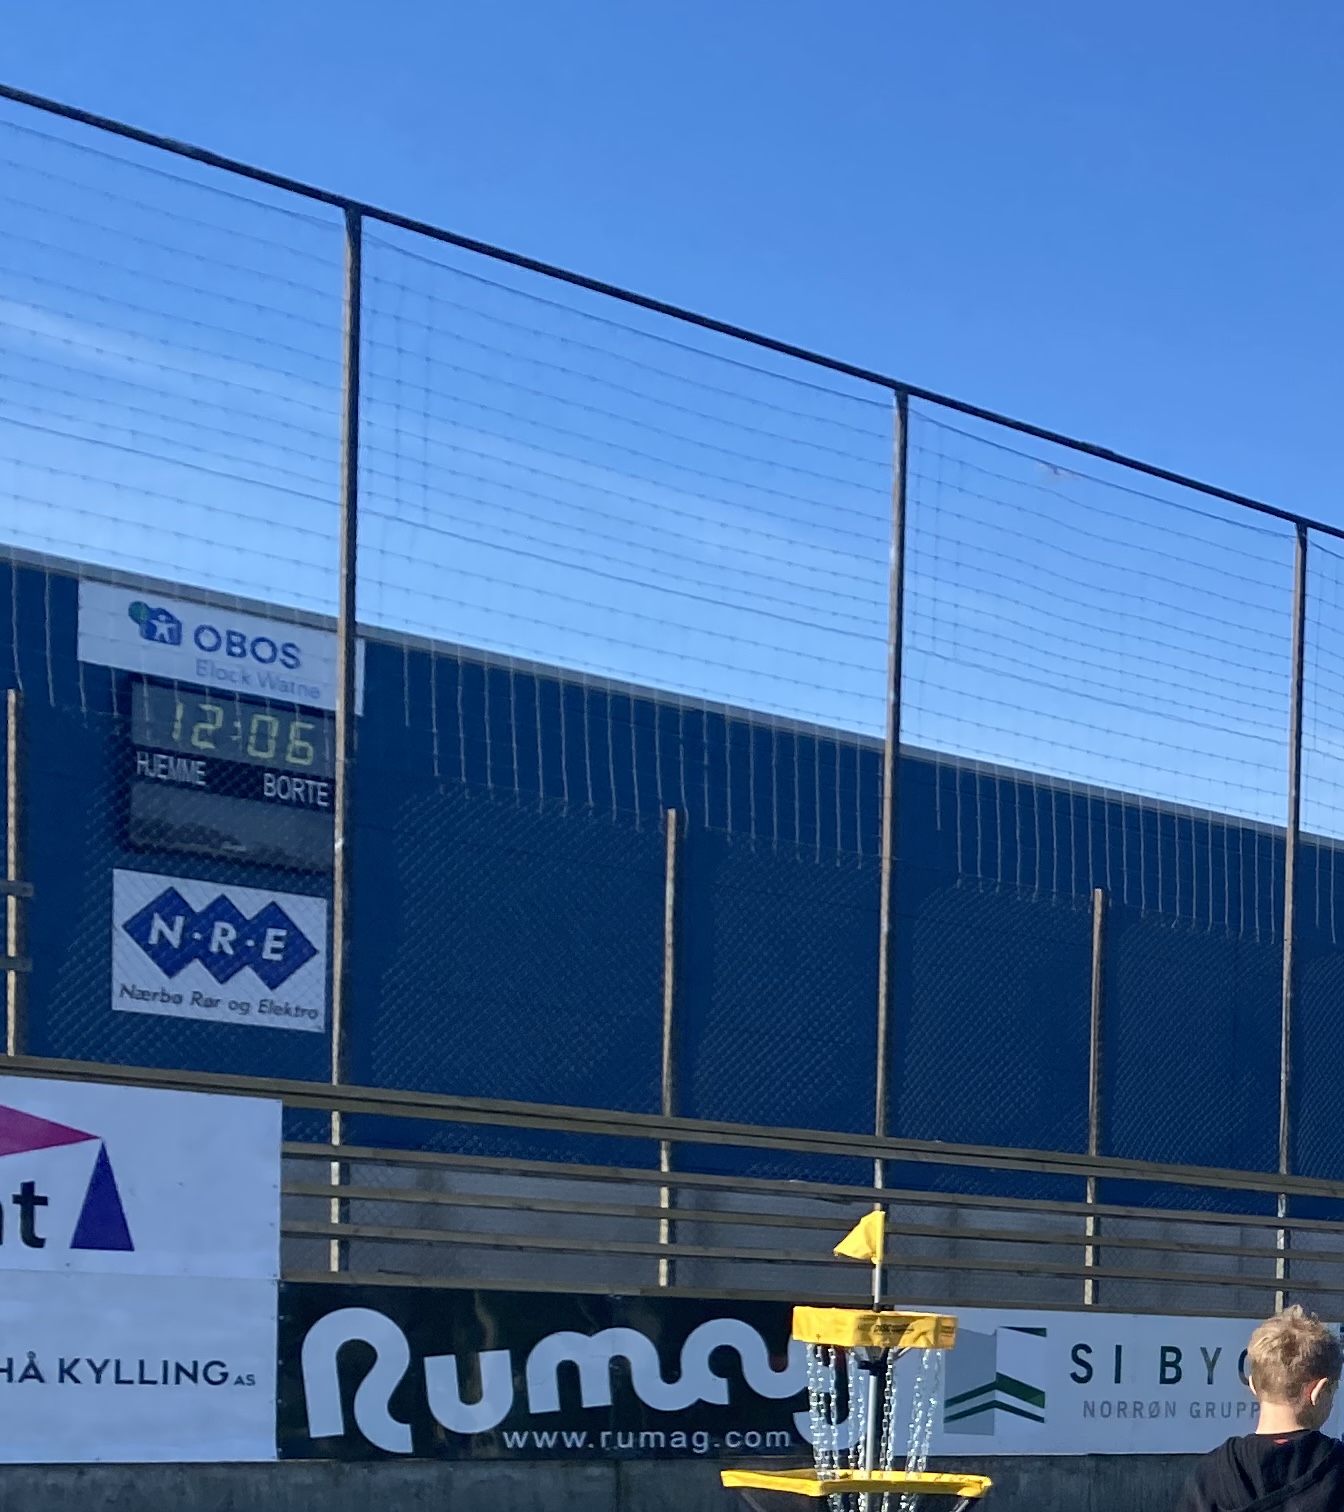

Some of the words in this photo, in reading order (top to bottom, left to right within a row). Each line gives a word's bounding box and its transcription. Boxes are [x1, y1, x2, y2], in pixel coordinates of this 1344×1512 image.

[194, 624, 302, 670] OBOS
[263, 772, 329, 807] BORTE
[228, 1001, 250, 1015] og
[257, 999, 319, 1020] Elektro
[58, 1358, 229, 1386] KYLLING
[233, 1374, 256, 1386] AS
[1083, 1400, 1176, 1419] NORRØN
[502, 1430, 791, 1453] www.rumag.com
